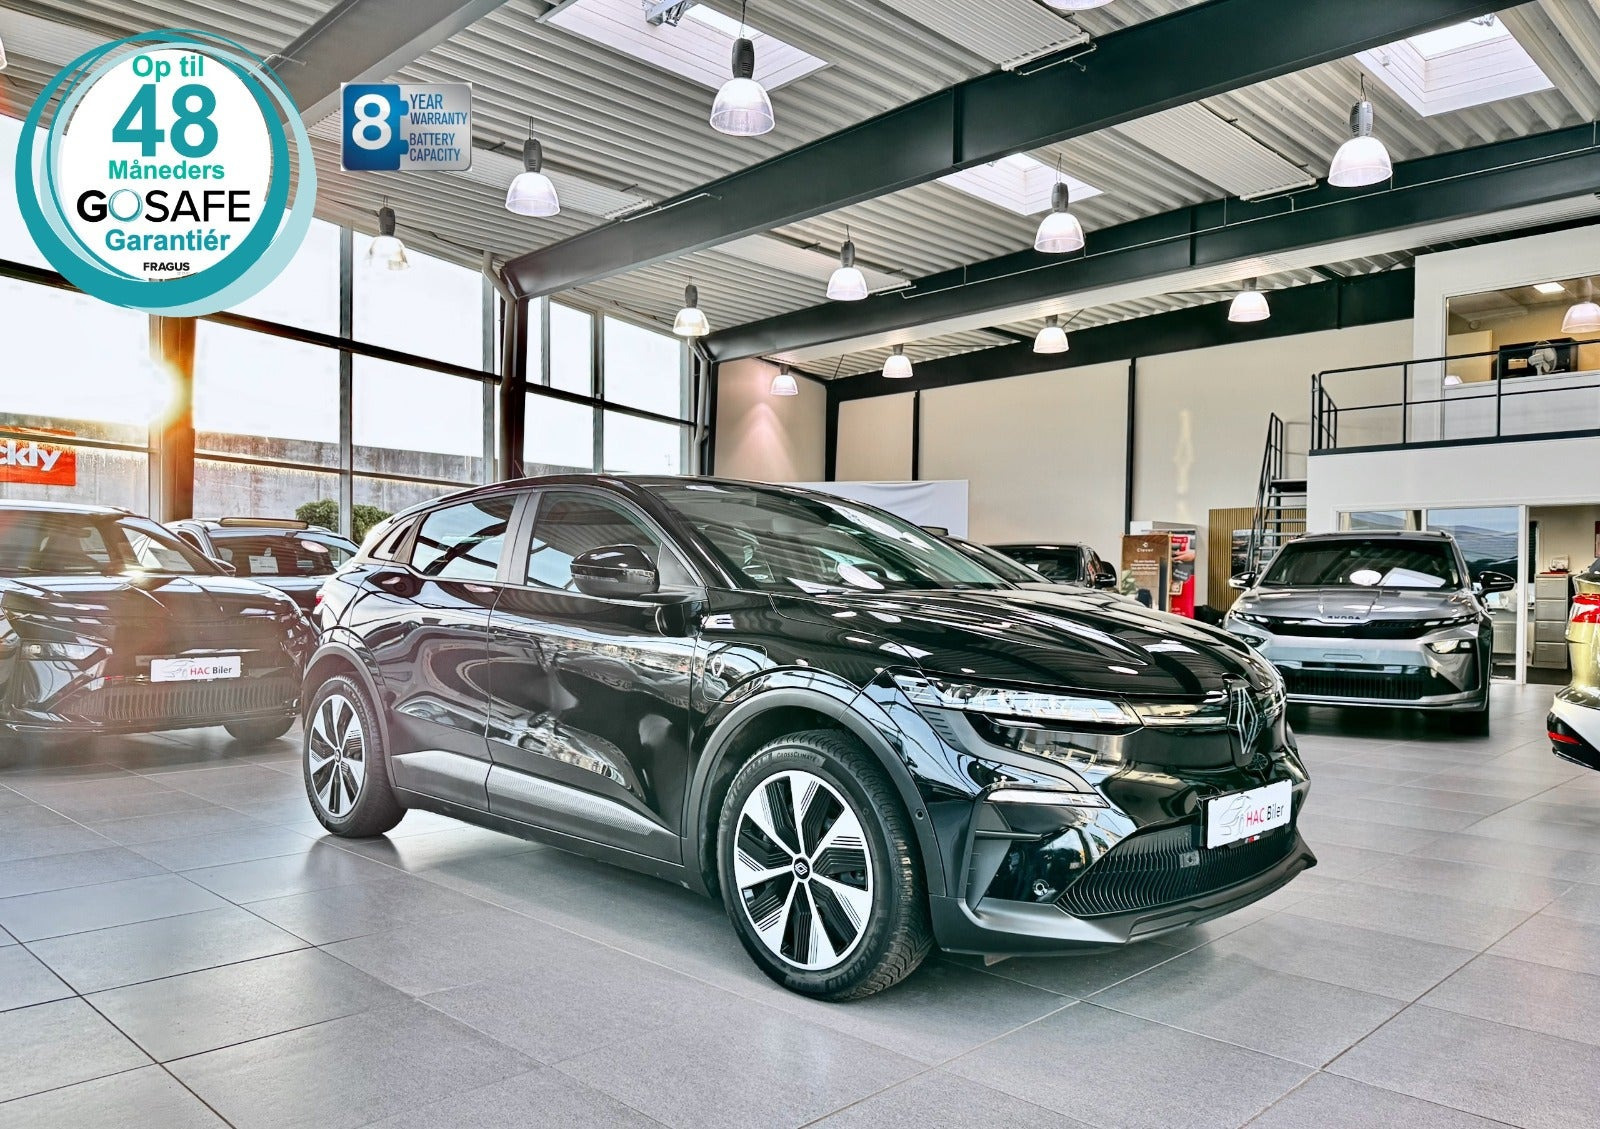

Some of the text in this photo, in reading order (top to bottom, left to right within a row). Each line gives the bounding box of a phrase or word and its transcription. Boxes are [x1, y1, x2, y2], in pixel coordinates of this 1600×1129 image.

[190, 665, 233, 676] HAC Biler
[1246, 804, 1285, 826] HAC Biler
